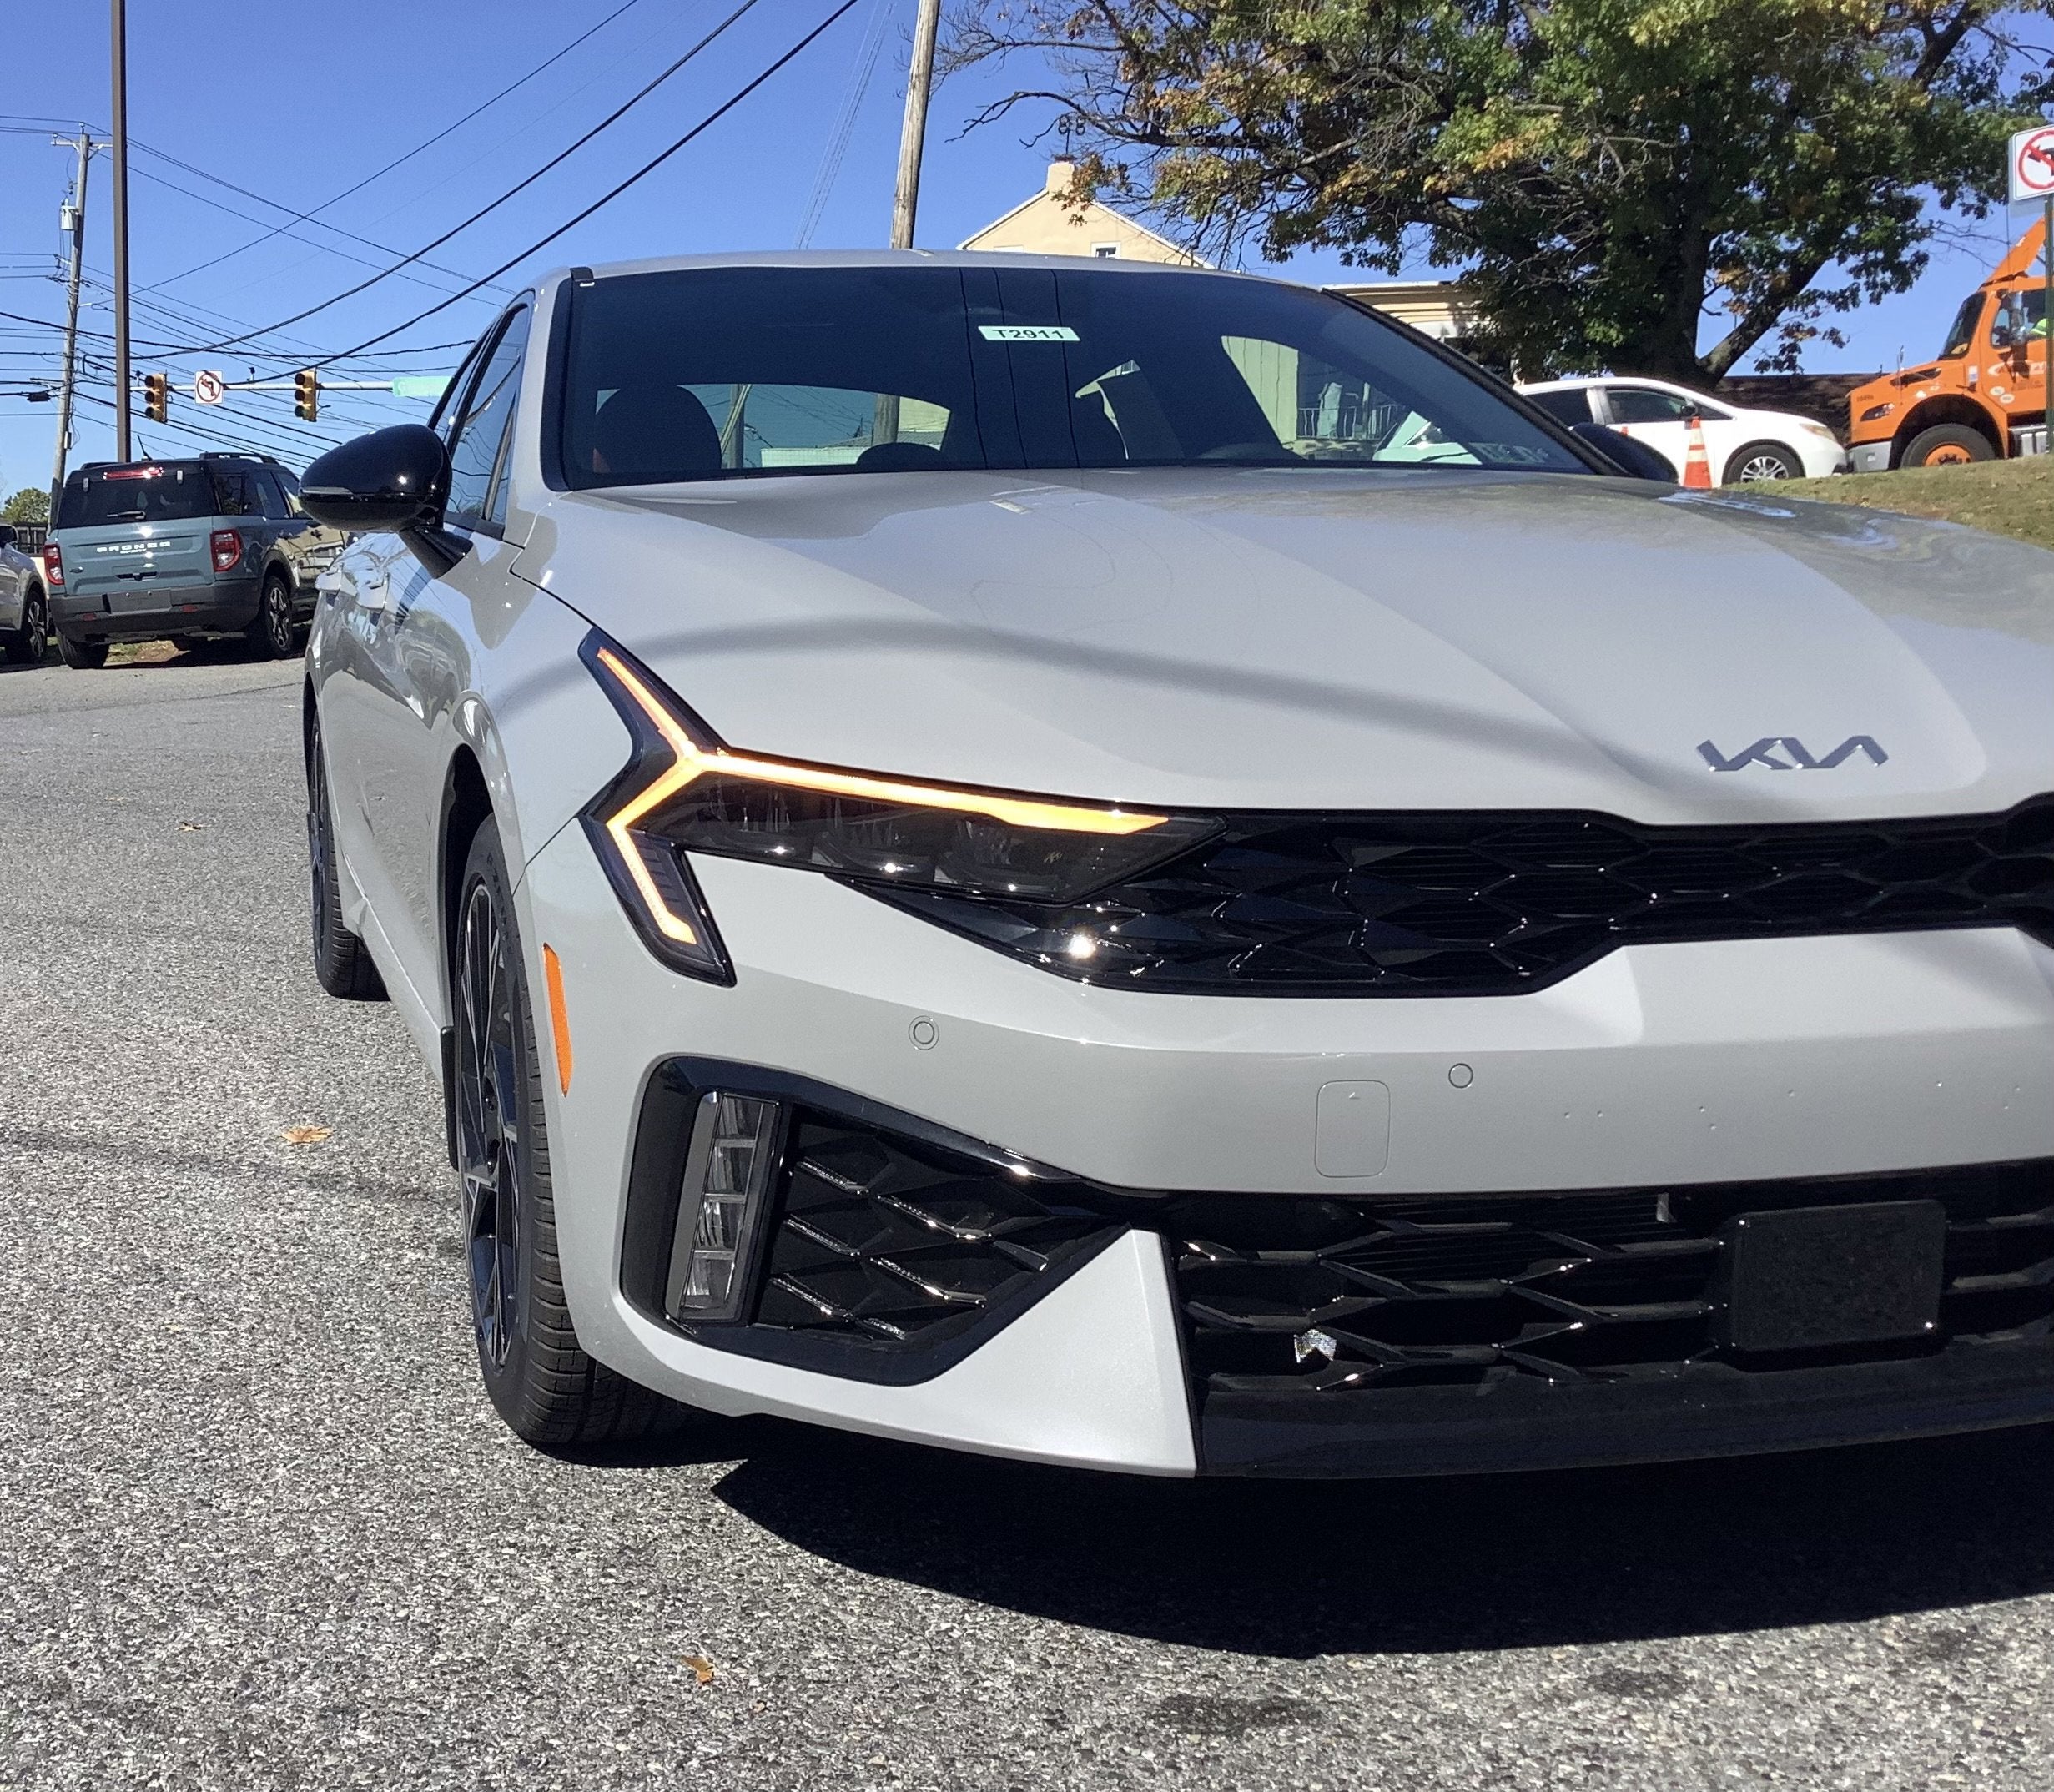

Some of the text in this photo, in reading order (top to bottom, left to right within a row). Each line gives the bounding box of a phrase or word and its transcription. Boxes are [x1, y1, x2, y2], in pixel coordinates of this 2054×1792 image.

[992, 329, 1065, 339] T2911
[96, 541, 171, 552] BRONCO
[1695, 735, 1889, 772] KIA
